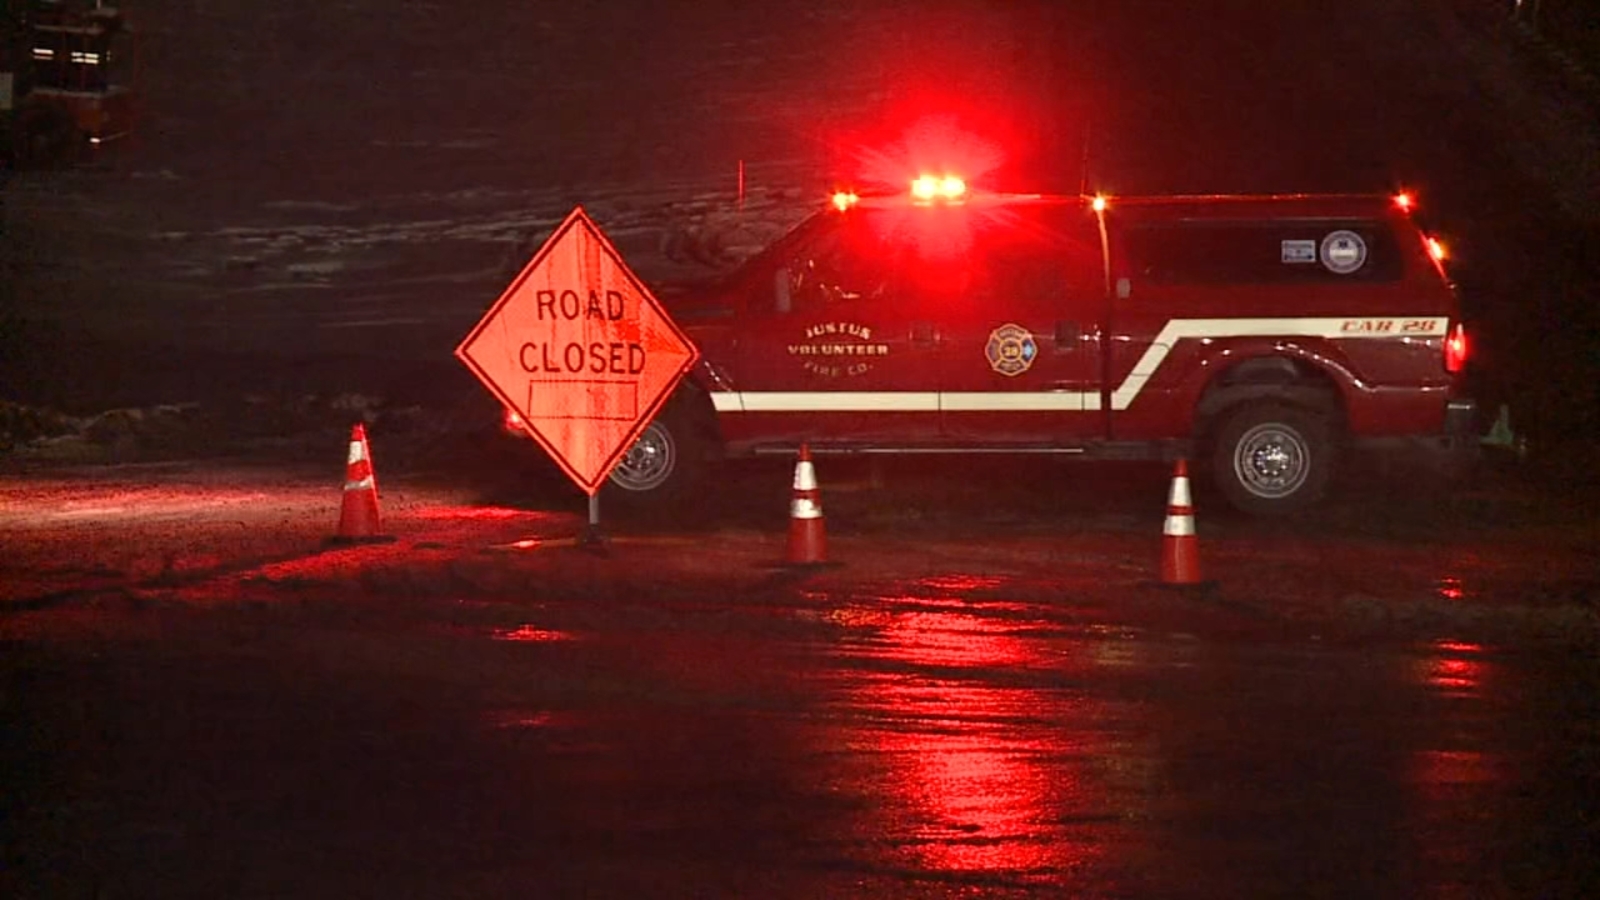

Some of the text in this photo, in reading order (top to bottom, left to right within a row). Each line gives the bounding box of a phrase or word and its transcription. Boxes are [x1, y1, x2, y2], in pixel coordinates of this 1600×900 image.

[536, 290, 625, 321] ROAD
[806, 322, 871, 340] JUSTUS
[1341, 320, 1393, 331] CAR
[519, 342, 646, 375] CLOSED
[787, 344, 889, 355] VOLUNTEER
